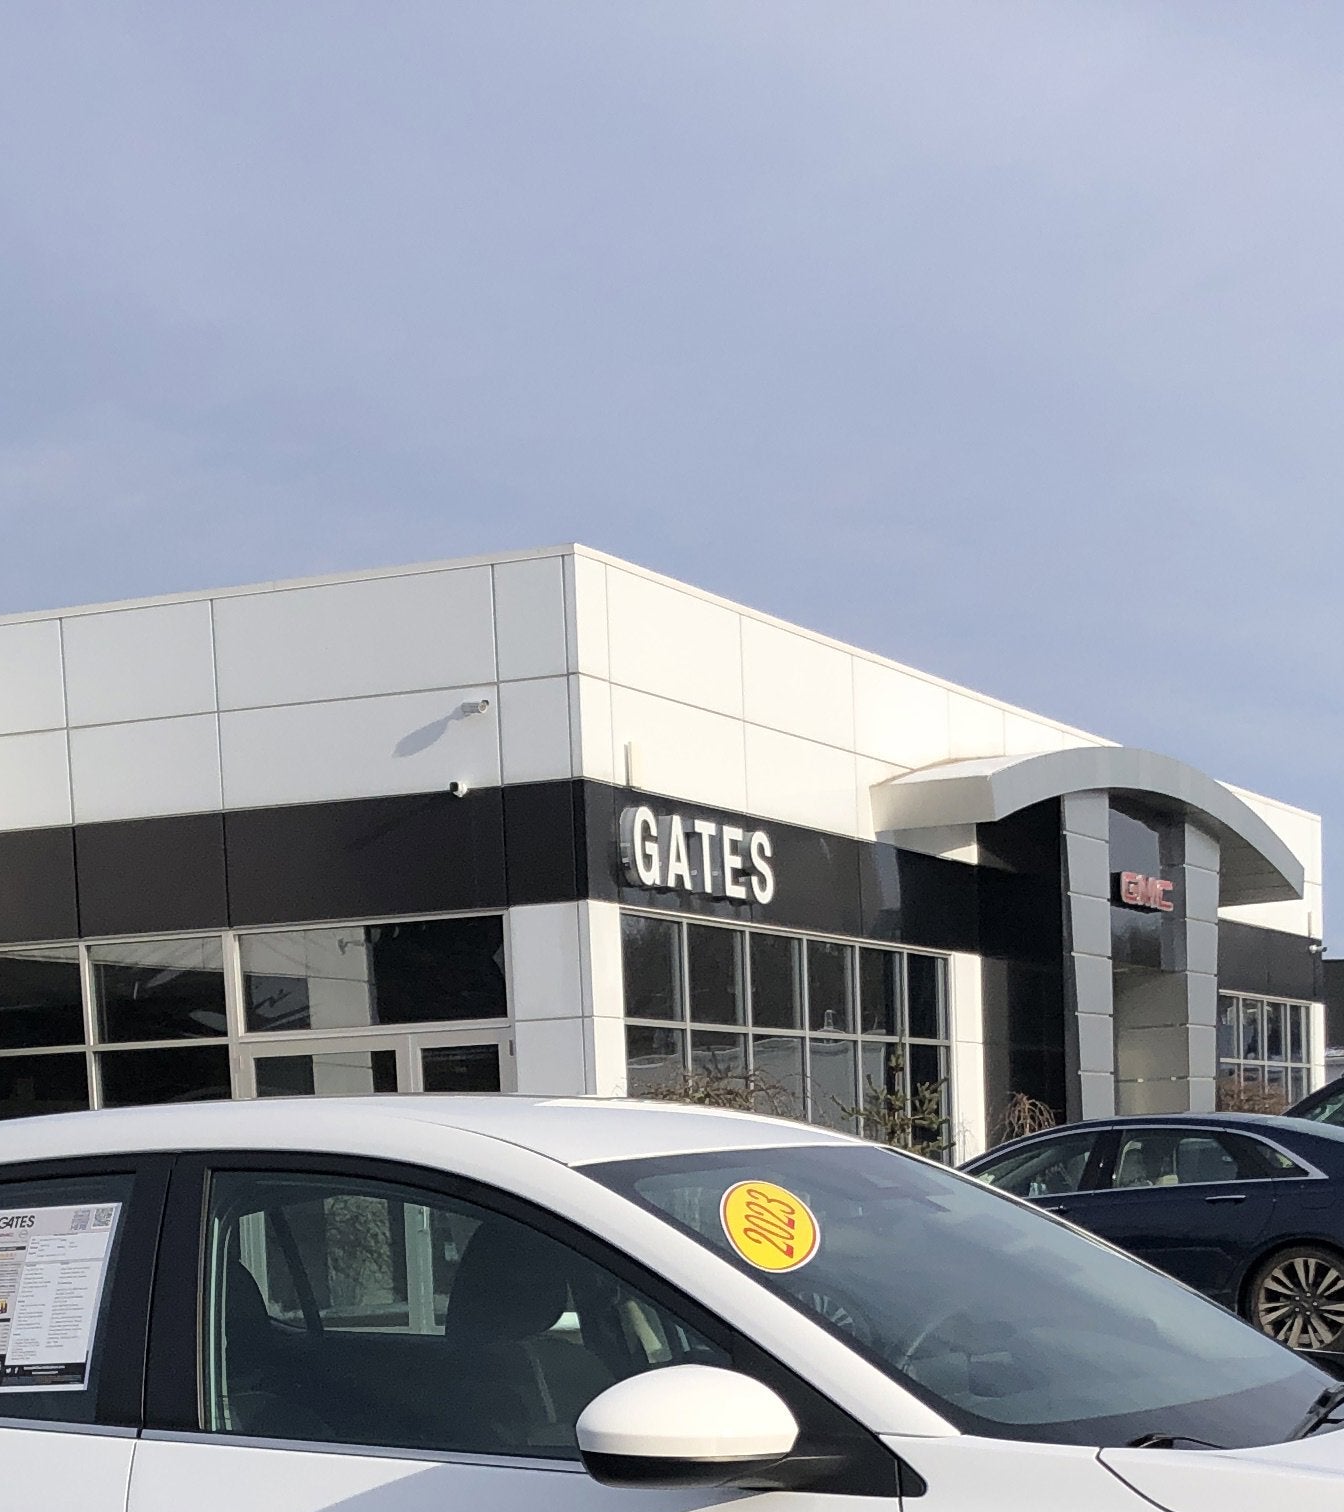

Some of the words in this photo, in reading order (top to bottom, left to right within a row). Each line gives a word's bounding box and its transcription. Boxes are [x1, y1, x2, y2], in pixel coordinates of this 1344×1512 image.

[633, 806, 775, 905] GATES
[1120, 871, 1174, 912] GMC
[743, 1188, 795, 1258] 2023
